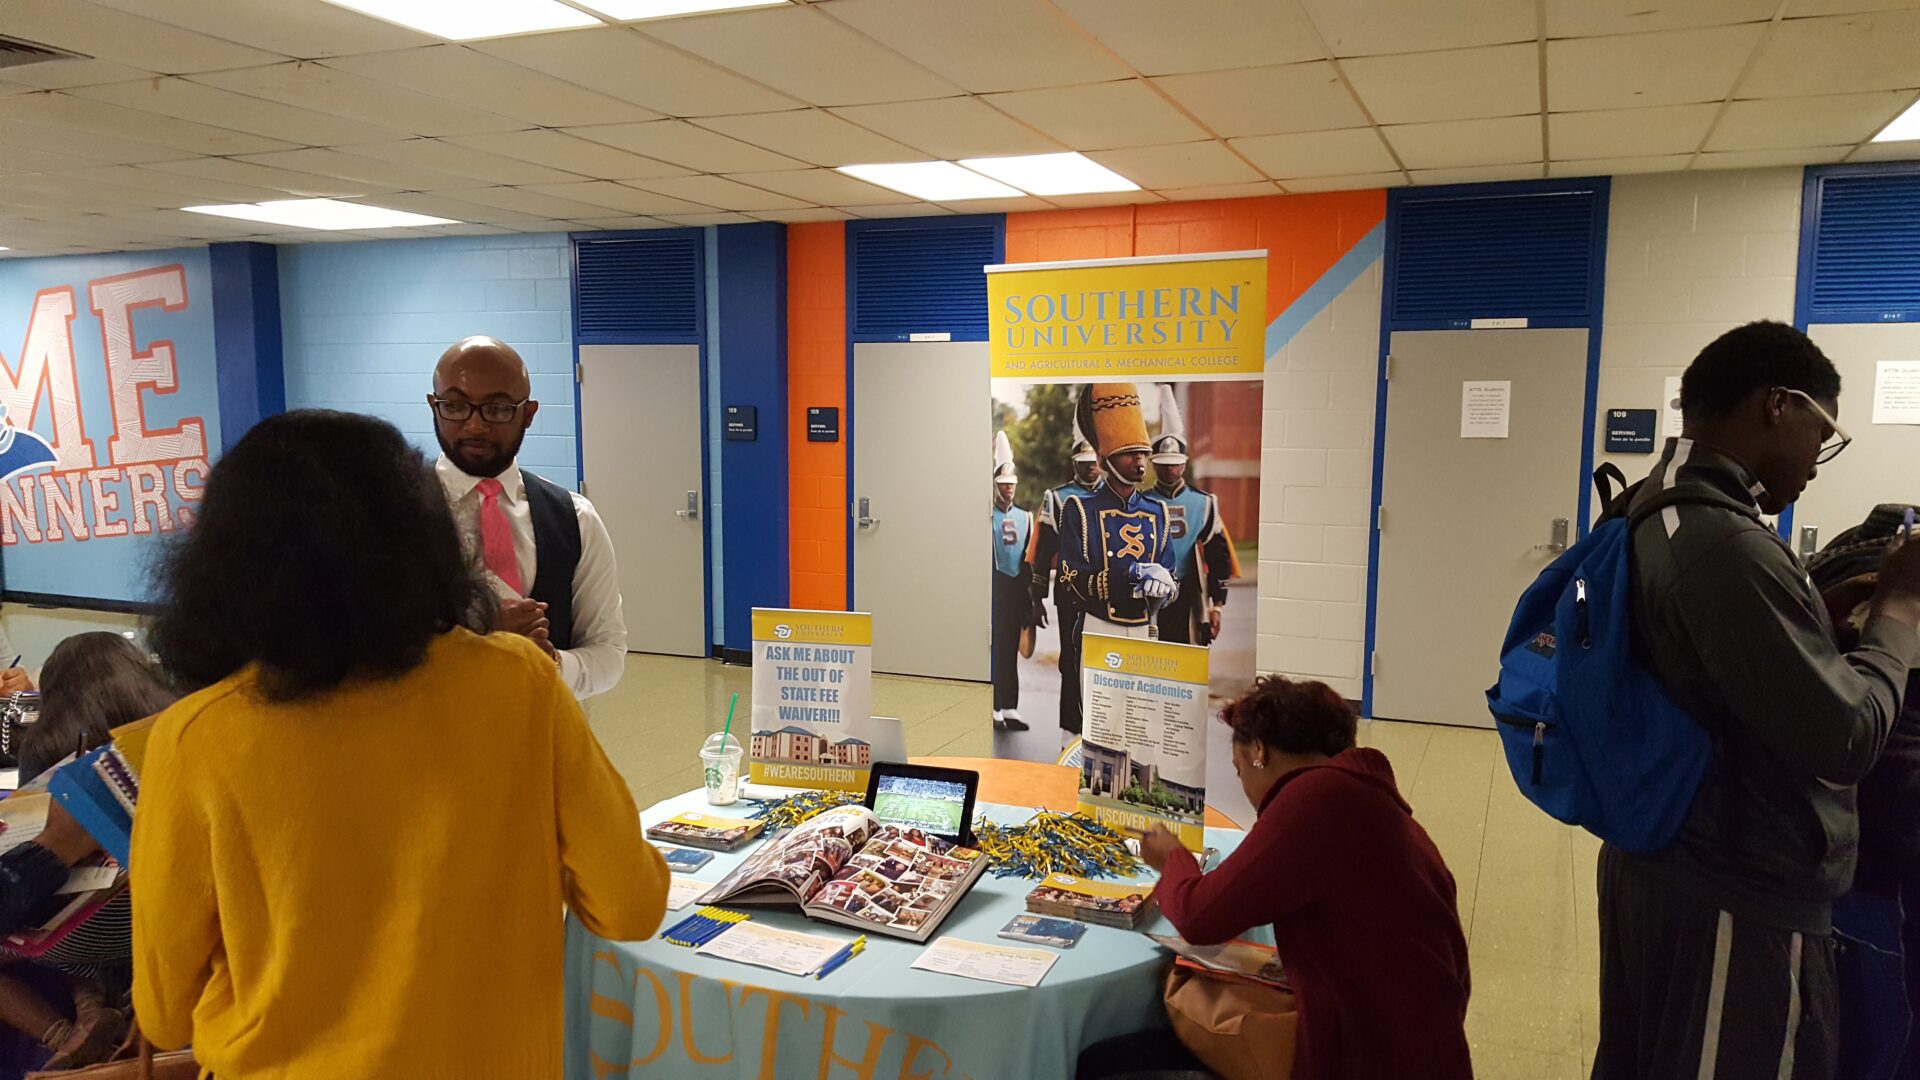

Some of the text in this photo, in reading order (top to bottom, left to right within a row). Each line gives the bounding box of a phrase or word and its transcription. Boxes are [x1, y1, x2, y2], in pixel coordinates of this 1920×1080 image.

[1004, 284, 1241, 325] SOUTHERN
[1006, 318, 1239, 349] UNIVERSITY
[1004, 355, 1239, 370] AND AGRICULTURAL & MECHANICAL COLLEGE
[1116, 522, 1146, 560] S
[765, 645, 856, 665] ASK ME ABOUT
[776, 666, 845, 684] THE OUT OF
[780, 686, 840, 703] STATE FEE
[1093, 673, 1193, 700] Discover Academics
[778, 705, 841, 724] WAIVER!!!
[763, 764, 856, 784] #WEARESOUTHERN
[1095, 806, 1146, 831] DISCOVER
